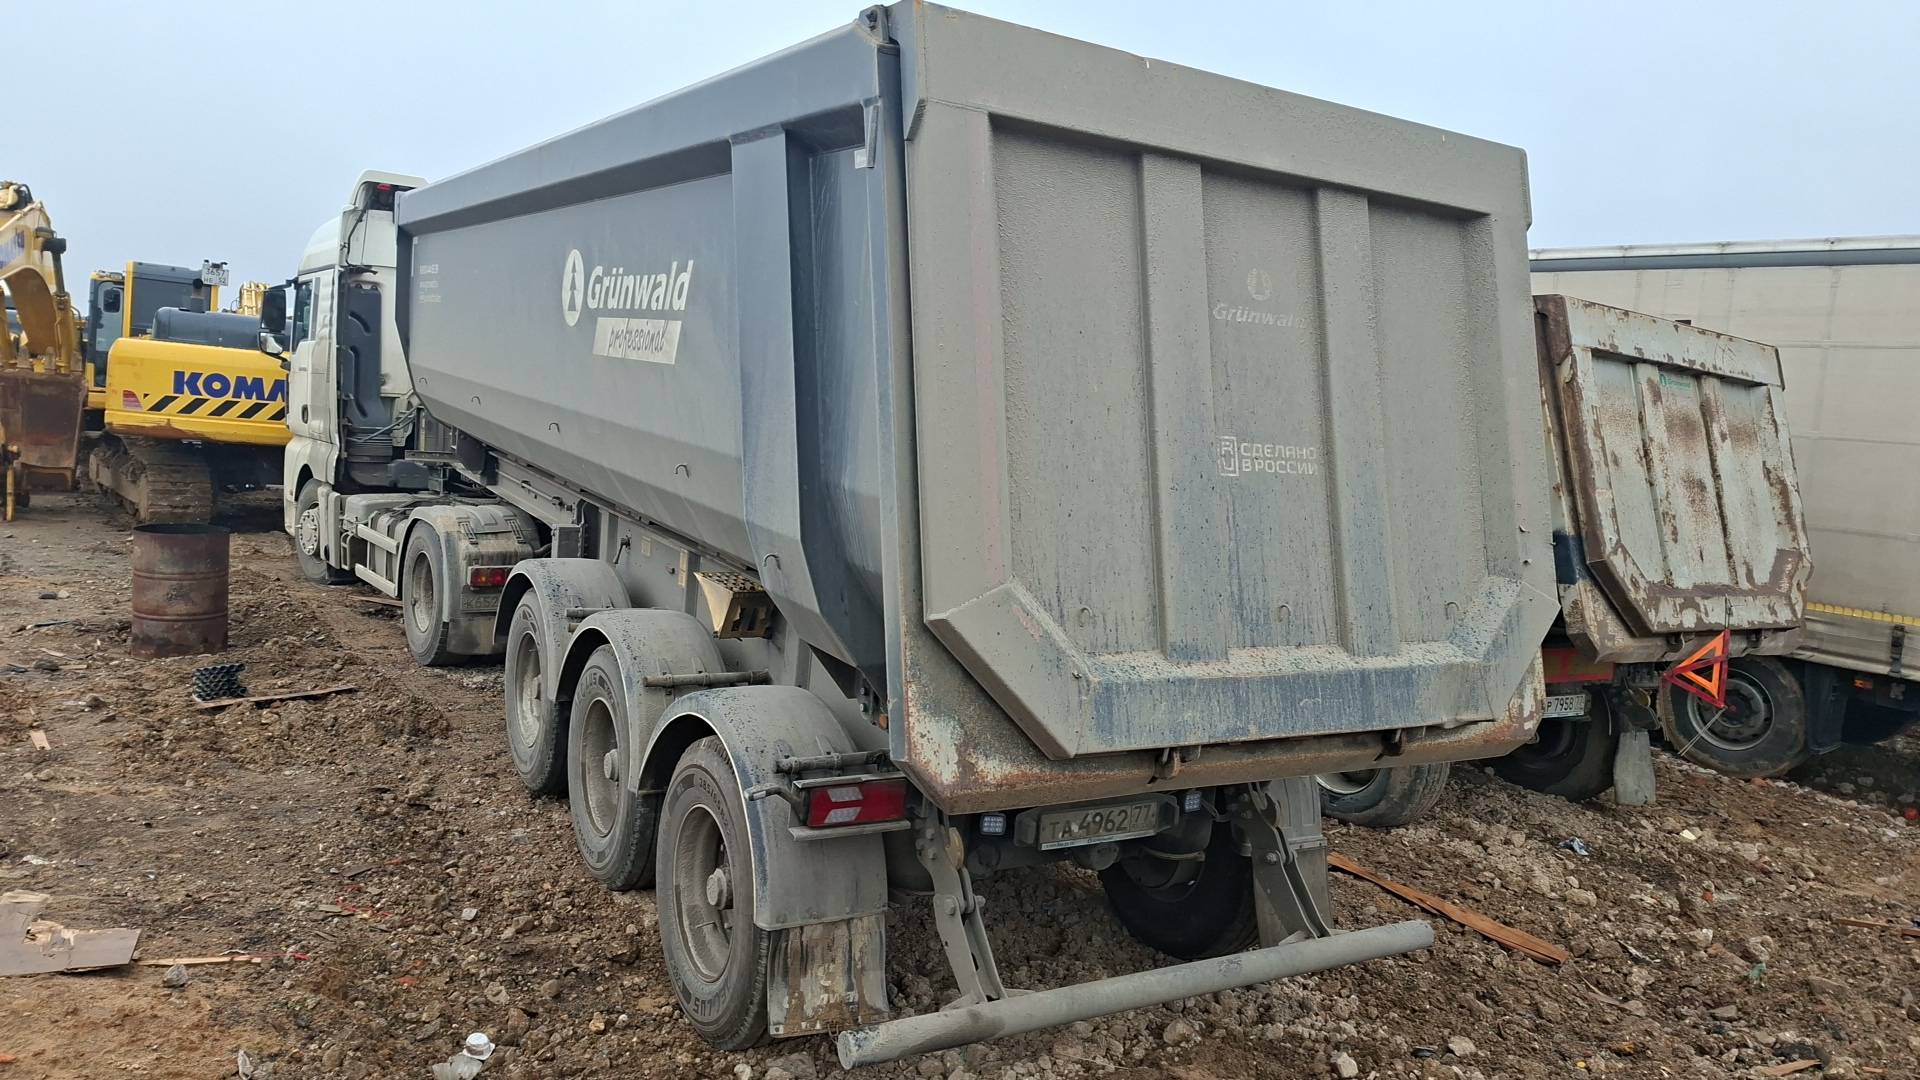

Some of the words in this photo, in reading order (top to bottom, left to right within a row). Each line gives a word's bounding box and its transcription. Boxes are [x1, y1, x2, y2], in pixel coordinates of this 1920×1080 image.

[587, 259, 694, 311] Grünwald
[606, 319, 669, 358] professional
[1240, 442, 1317, 460] СДЕЛАНО
